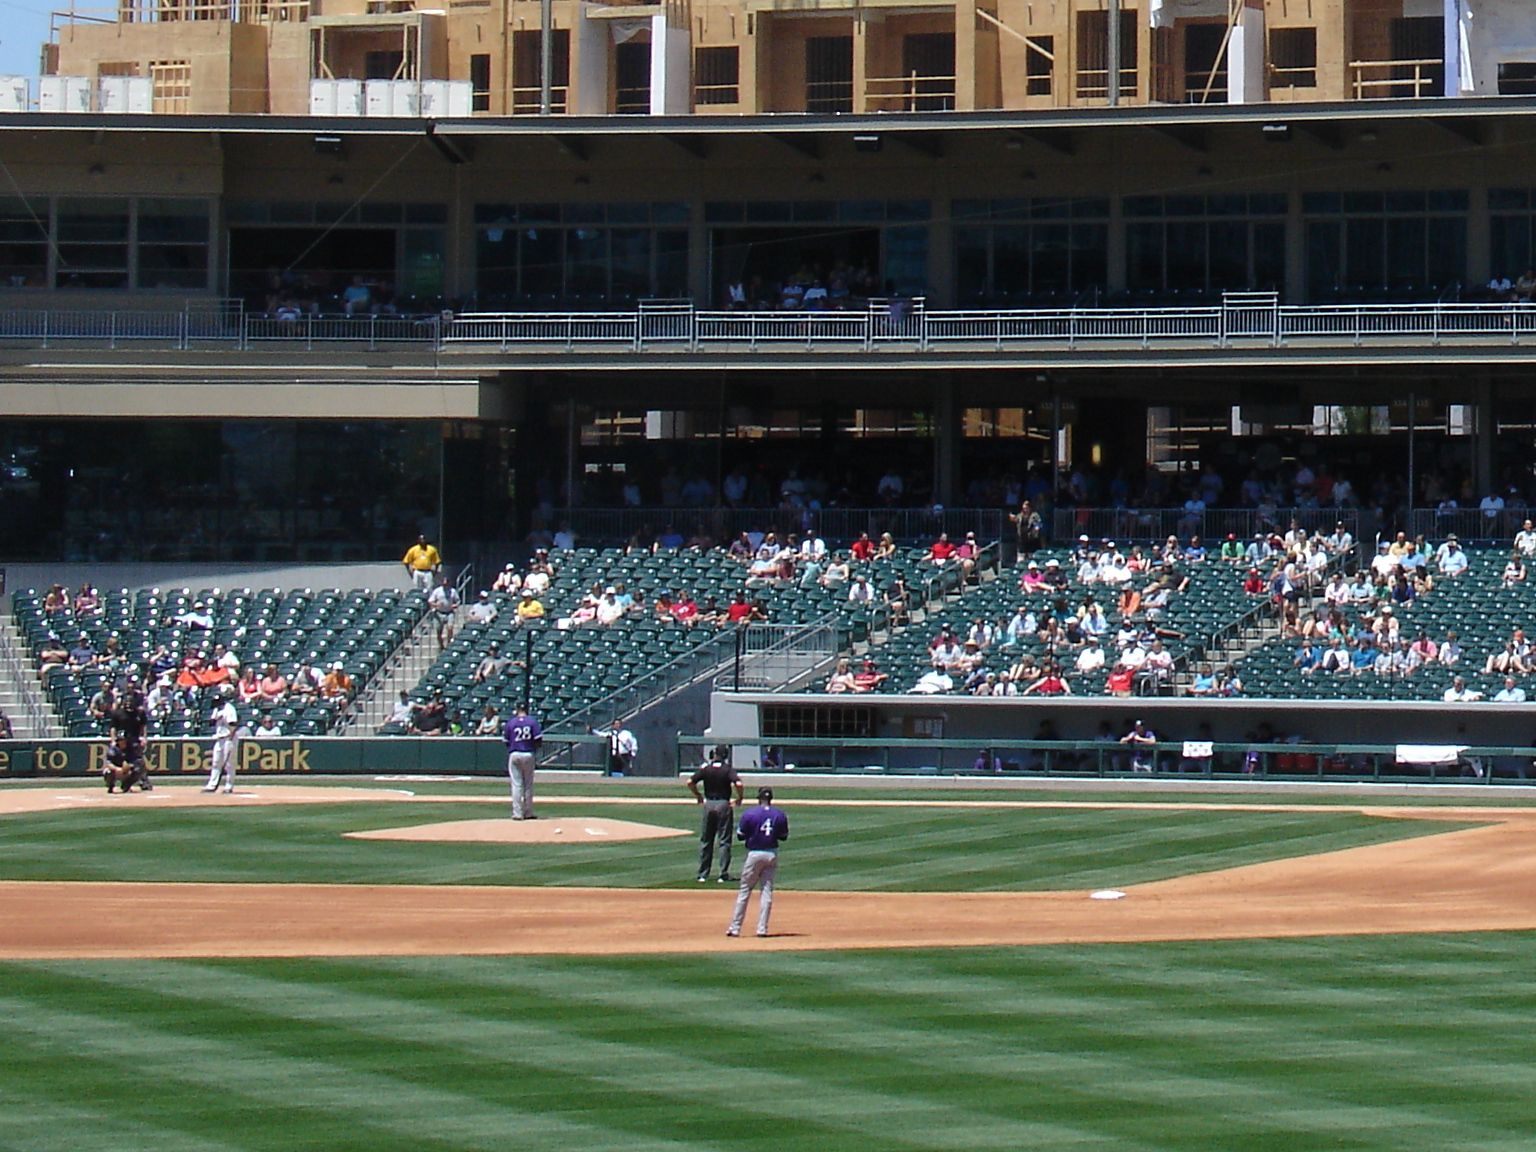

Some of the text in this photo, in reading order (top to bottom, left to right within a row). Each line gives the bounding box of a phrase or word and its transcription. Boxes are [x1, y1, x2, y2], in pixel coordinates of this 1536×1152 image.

[513, 726, 532, 742] 28
[36, 745, 69, 770] to
[759, 818, 773, 837] 4
